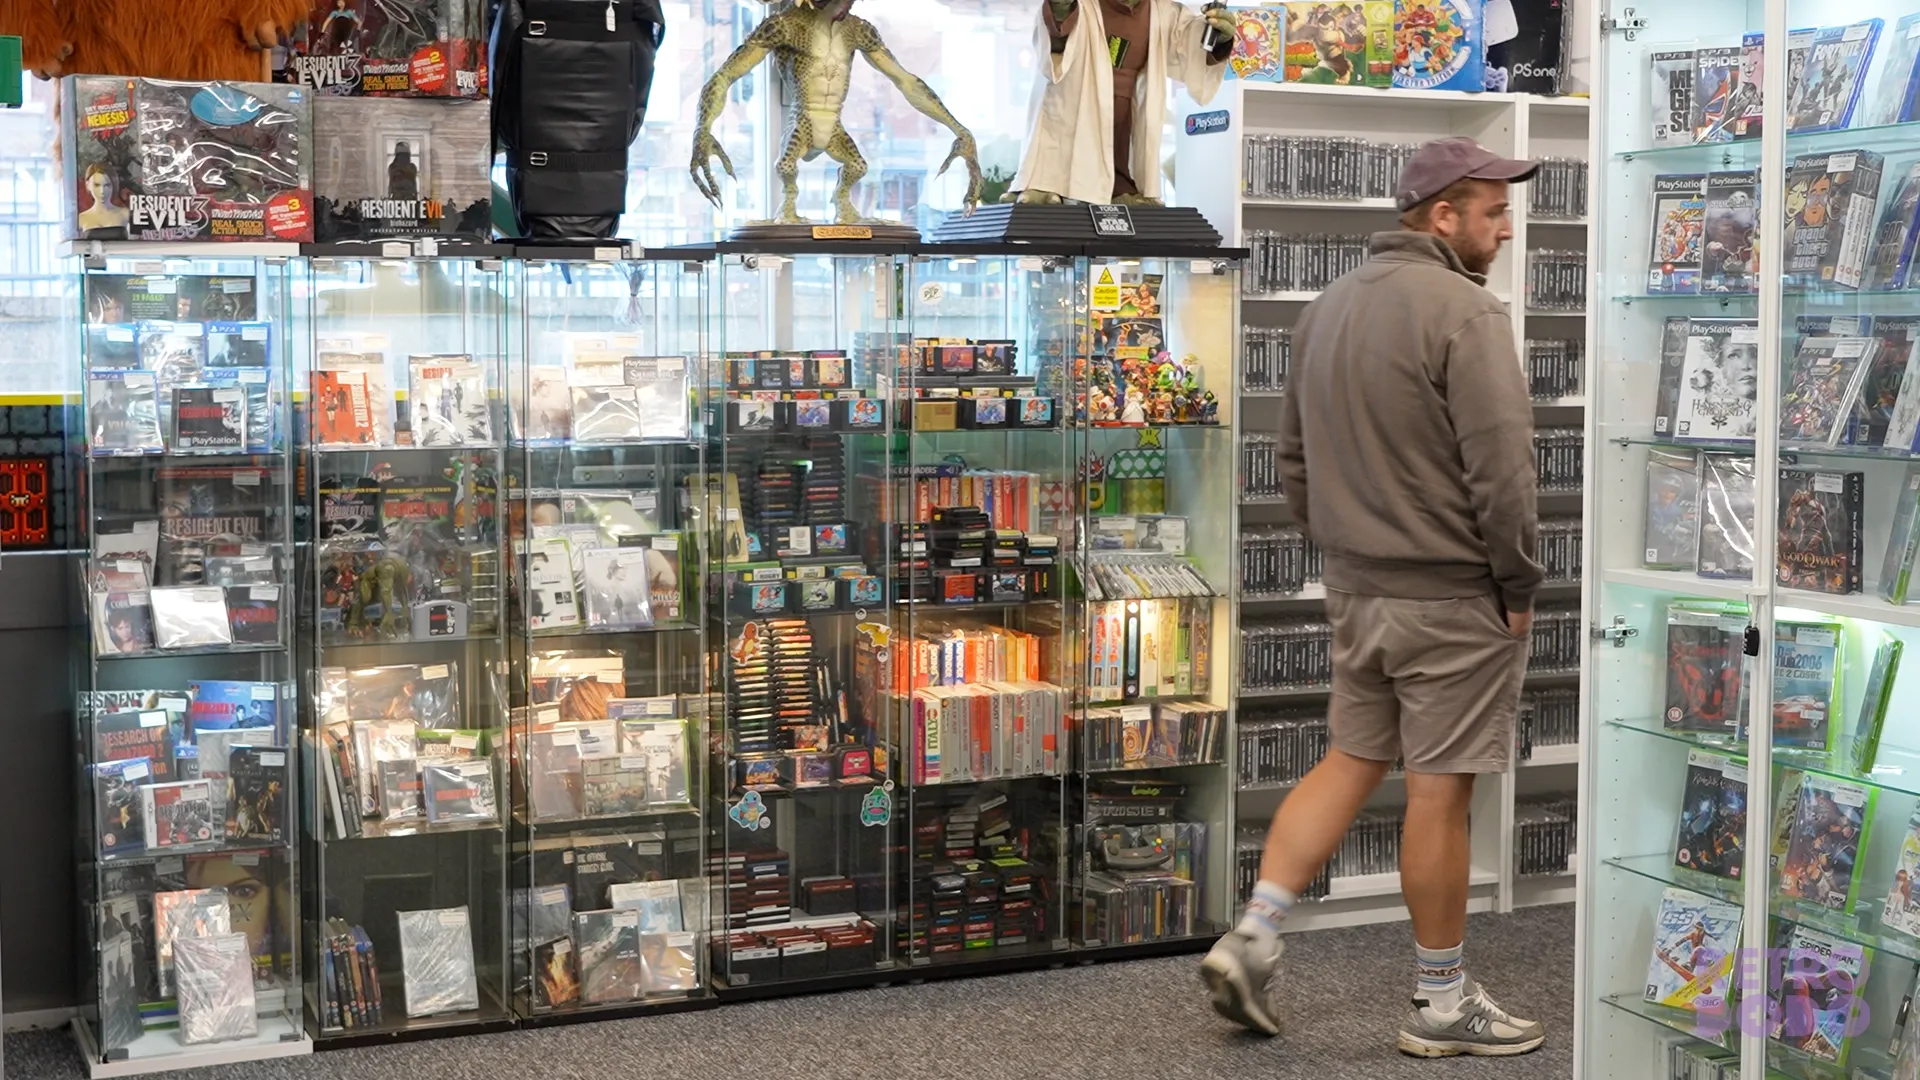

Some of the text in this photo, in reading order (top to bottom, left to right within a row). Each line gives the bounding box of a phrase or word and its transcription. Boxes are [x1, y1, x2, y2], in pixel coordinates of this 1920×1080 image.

[430, 51, 441, 63] 2
[1811, 40, 1861, 63] FORTNITE
[296, 56, 347, 72] RESIDENT
[1513, 63, 1557, 77] PS one
[1699, 56, 1740, 68] SPIDE
[299, 69, 347, 90] EVIL
[363, 83, 386, 91] ACTION
[87, 111, 130, 127] NEMESIS!
[1195, 114, 1228, 130] PlayStation
[1795, 158, 1829, 171] PlayStation
[1710, 176, 1747, 186] PlayStation
[130, 195, 193, 211] RESIDENT
[288, 199, 301, 211] 3
[361, 200, 446, 219] RESIDENT EVIL
[134, 196, 212, 231] EVIL 3
[212, 220, 264, 228] REAL SHOCK
[390, 219, 418, 227] biohazard
[211, 227, 265, 236] ACTION FIGURE
[1794, 226, 1826, 243] grand
[1795, 242, 1829, 257] theft
[1791, 256, 1819, 269] auto
[217, 325, 236, 333] PS4
[1691, 324, 1733, 336] PlayStatio
[1697, 409, 1744, 417] GROUND
[192, 436, 237, 447] PlayStation
[166, 516, 262, 536] RESIDENT EVIL
[1783, 552, 1839, 568] GOD WAR
[943, 641, 953, 678] DEFENDER
[1795, 654, 1823, 670] 2006
[77, 691, 146, 710] RESIDENT
[992, 696, 1000, 720] JOUST
[102, 729, 149, 747] RESEARCH
[927, 719, 938, 750] ITALY
[157, 743, 165, 758] 2
[1799, 940, 1855, 965] SPIDER-MAN
[1465, 1015, 1489, 1034] N
